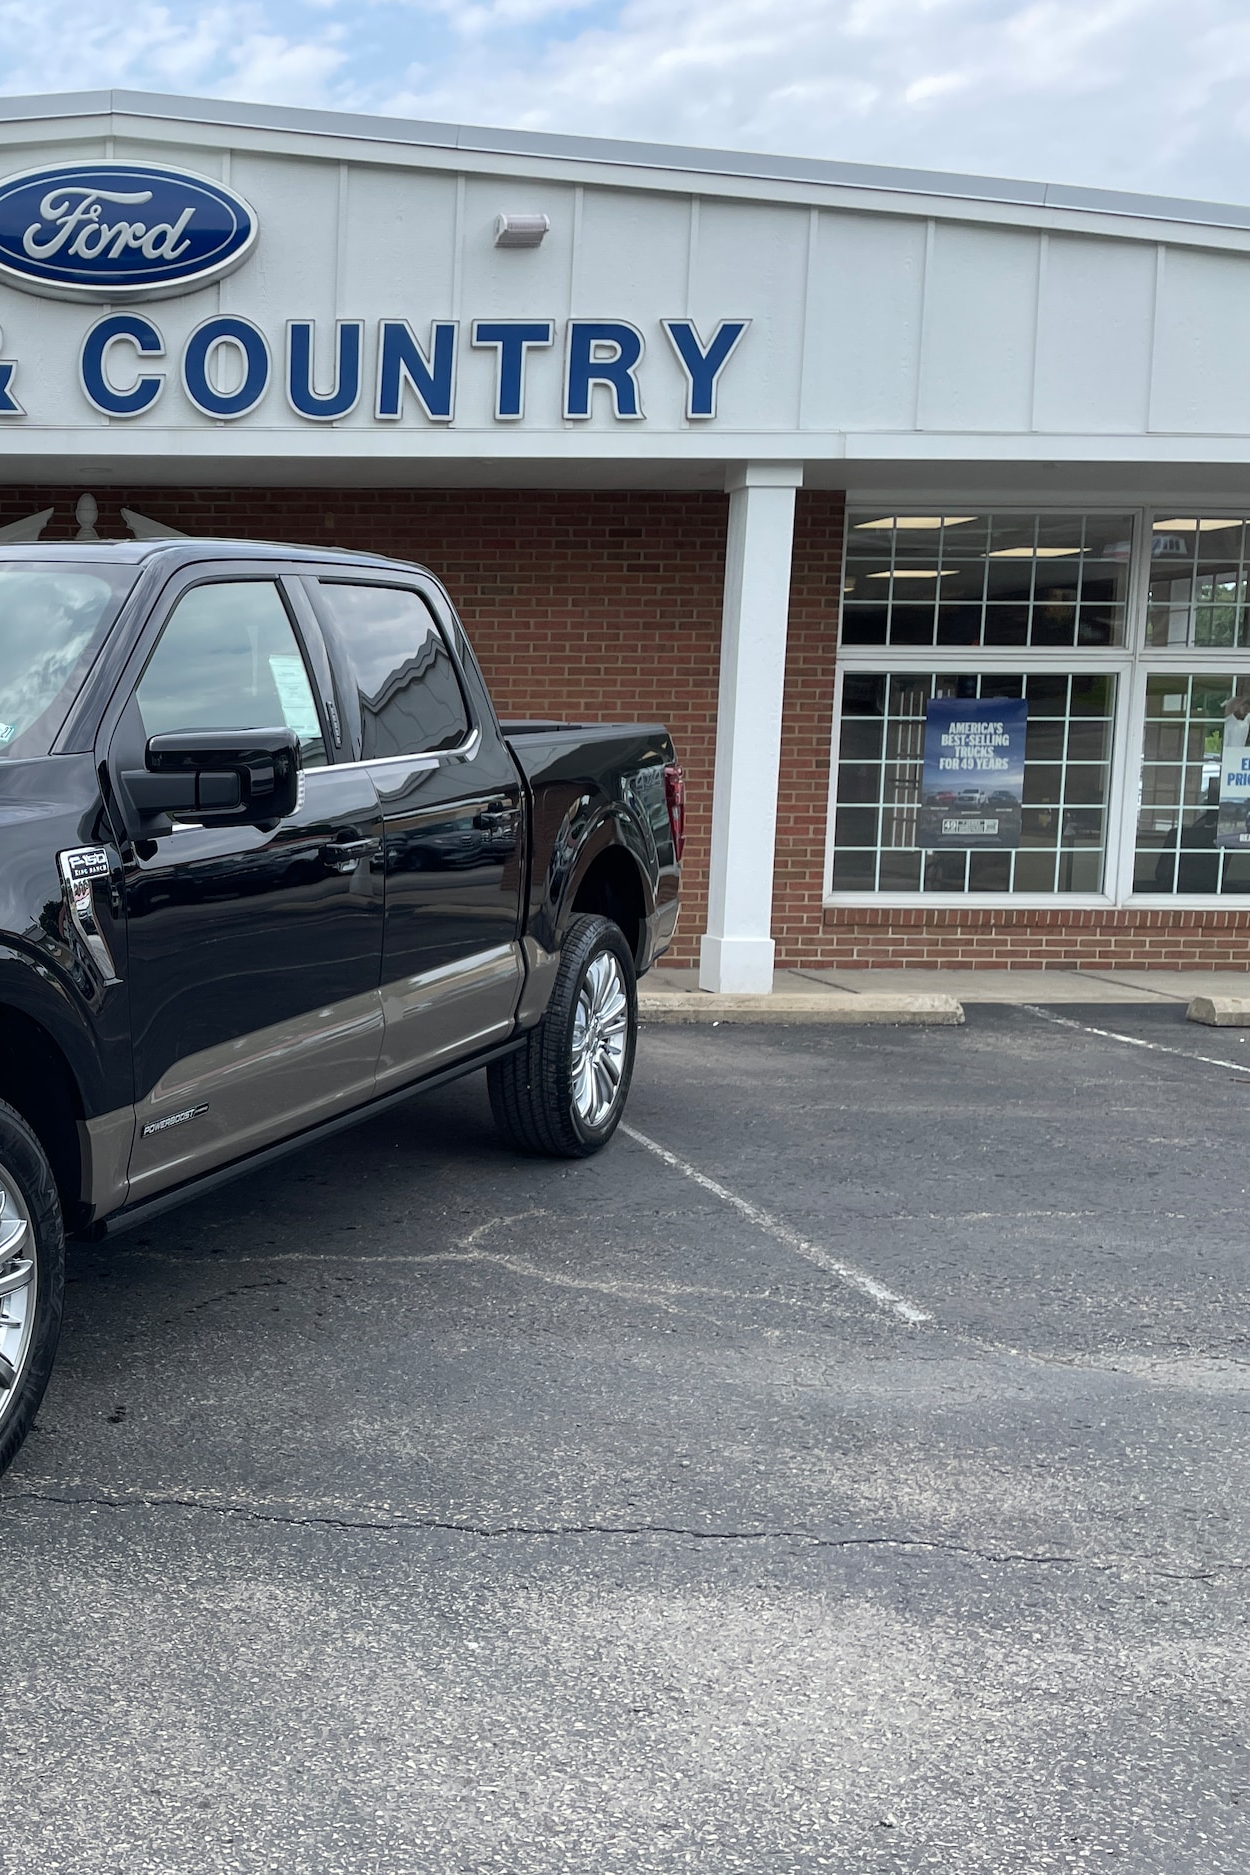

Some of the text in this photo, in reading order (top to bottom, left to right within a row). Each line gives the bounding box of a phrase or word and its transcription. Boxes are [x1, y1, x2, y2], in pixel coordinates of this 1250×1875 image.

[23, 187, 196, 260] Ford
[79, 310, 752, 421] COUNTRY
[948, 722, 1003, 735] AMERICA'S
[941, 734, 1010, 746] BEST-SELLING
[954, 746, 994, 758] TRUCKS
[939, 758, 1009, 770] FOR 49 YEARS
[69, 853, 107, 868] F-150
[143, 1108, 196, 1135] POWERBOOST
